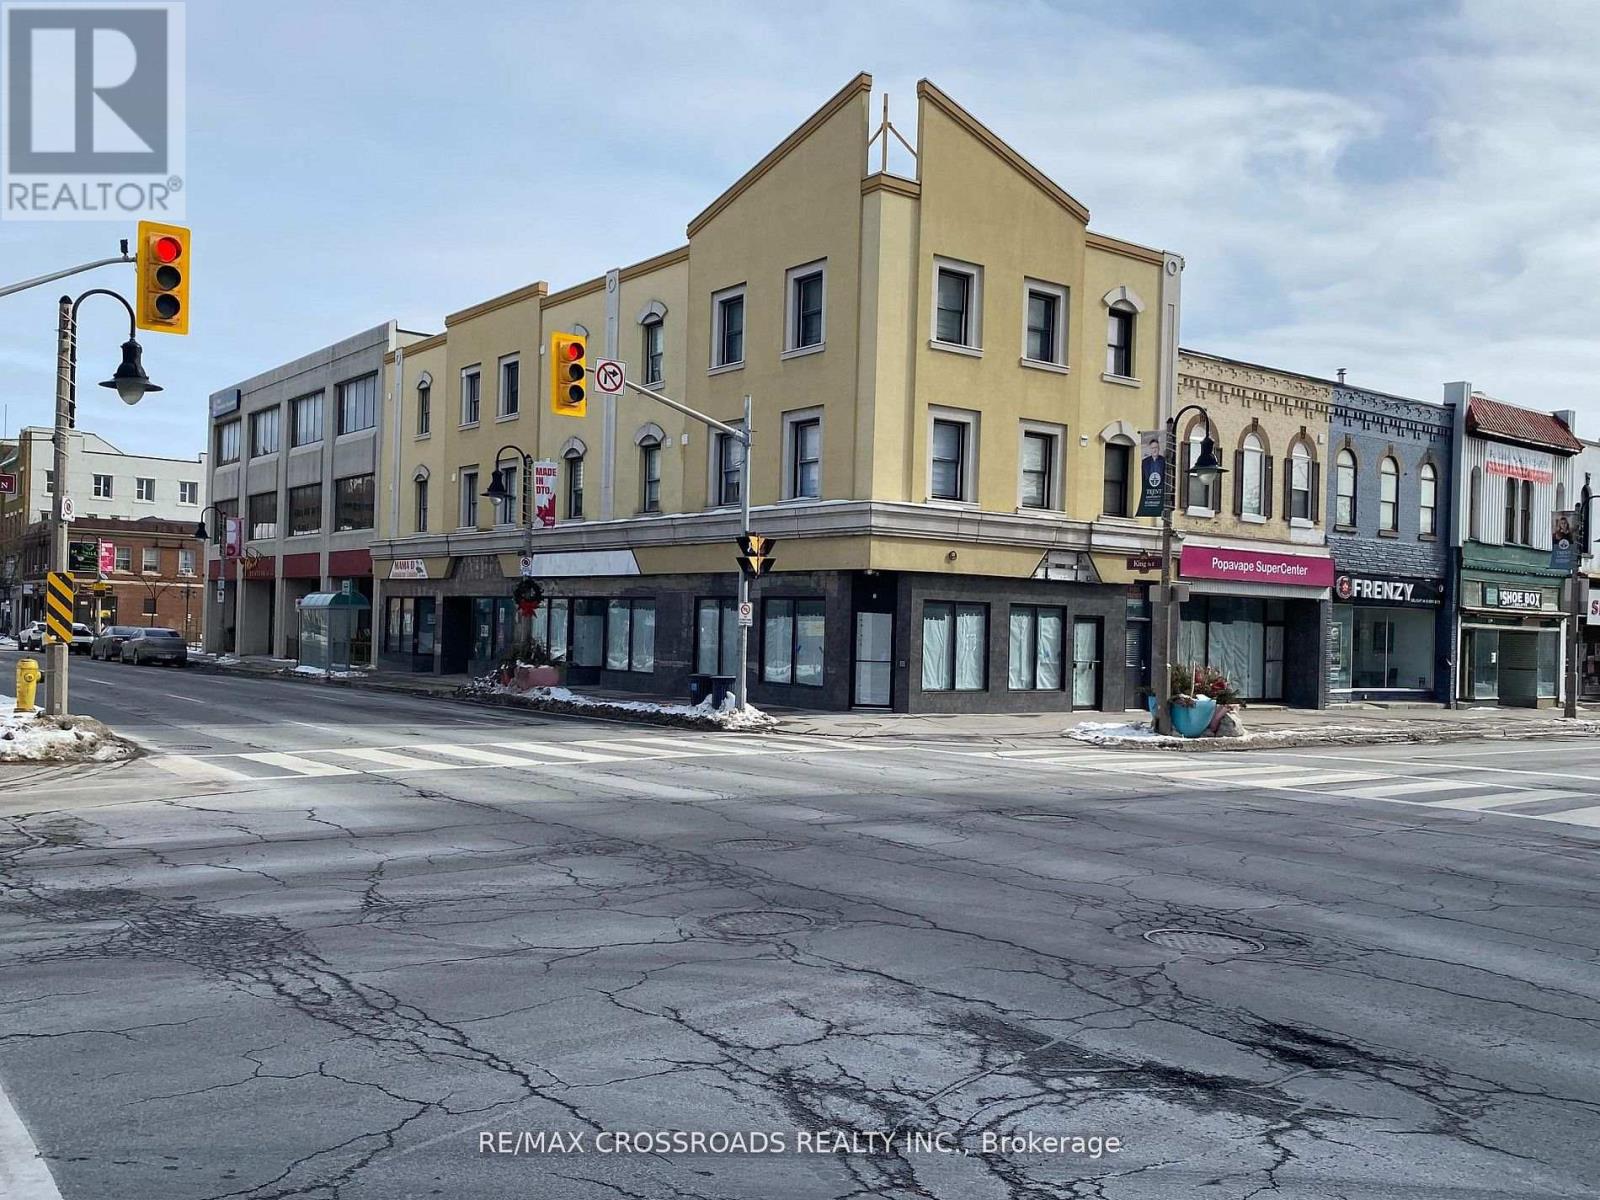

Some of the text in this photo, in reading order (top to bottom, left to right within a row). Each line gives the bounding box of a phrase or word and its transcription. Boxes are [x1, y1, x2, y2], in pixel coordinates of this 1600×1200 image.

[536, 467, 557, 476] MADE
[536, 477, 544, 485] IN
[1133, 559, 1147, 568] King
[1212, 557, 1308, 576] Popavape SuperCenter
[1352, 579, 1414, 601] FRENZY
[1502, 591, 1541, 608] SHOE BOX
